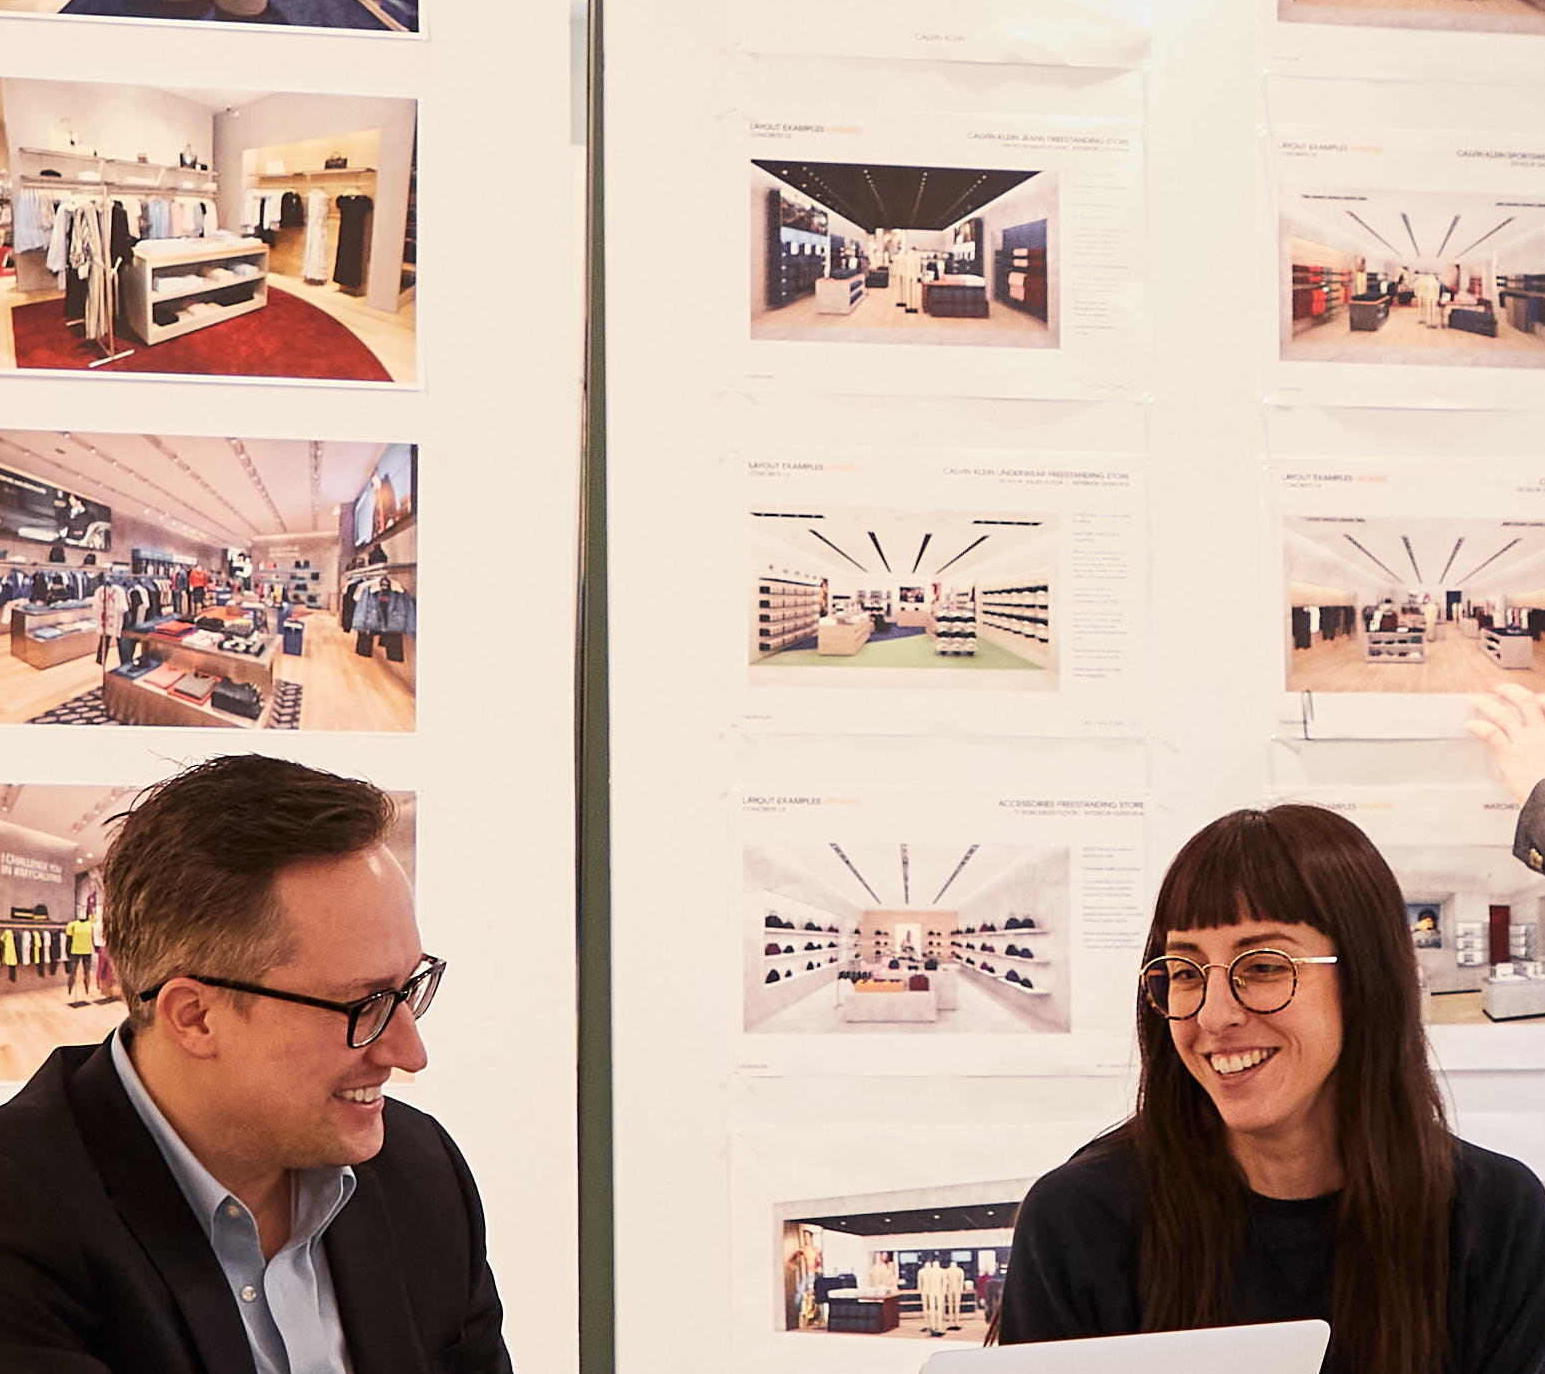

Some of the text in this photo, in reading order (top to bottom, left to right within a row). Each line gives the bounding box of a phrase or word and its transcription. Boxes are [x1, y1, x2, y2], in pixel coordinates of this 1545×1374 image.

[749, 122, 781, 131] LAYOUT
[783, 123, 824, 133] EXAMPLES
[748, 461, 780, 470] LAYOUT
[782, 462, 823, 471] EXAMPLES
[776, 797, 822, 805] EXAMPLES
[999, 800, 1055, 808] ACCESSORIES
[6, 852, 48, 870] CHALLENGE
[49, 862, 63, 873] YOU
[0, 864, 12, 876] IN
